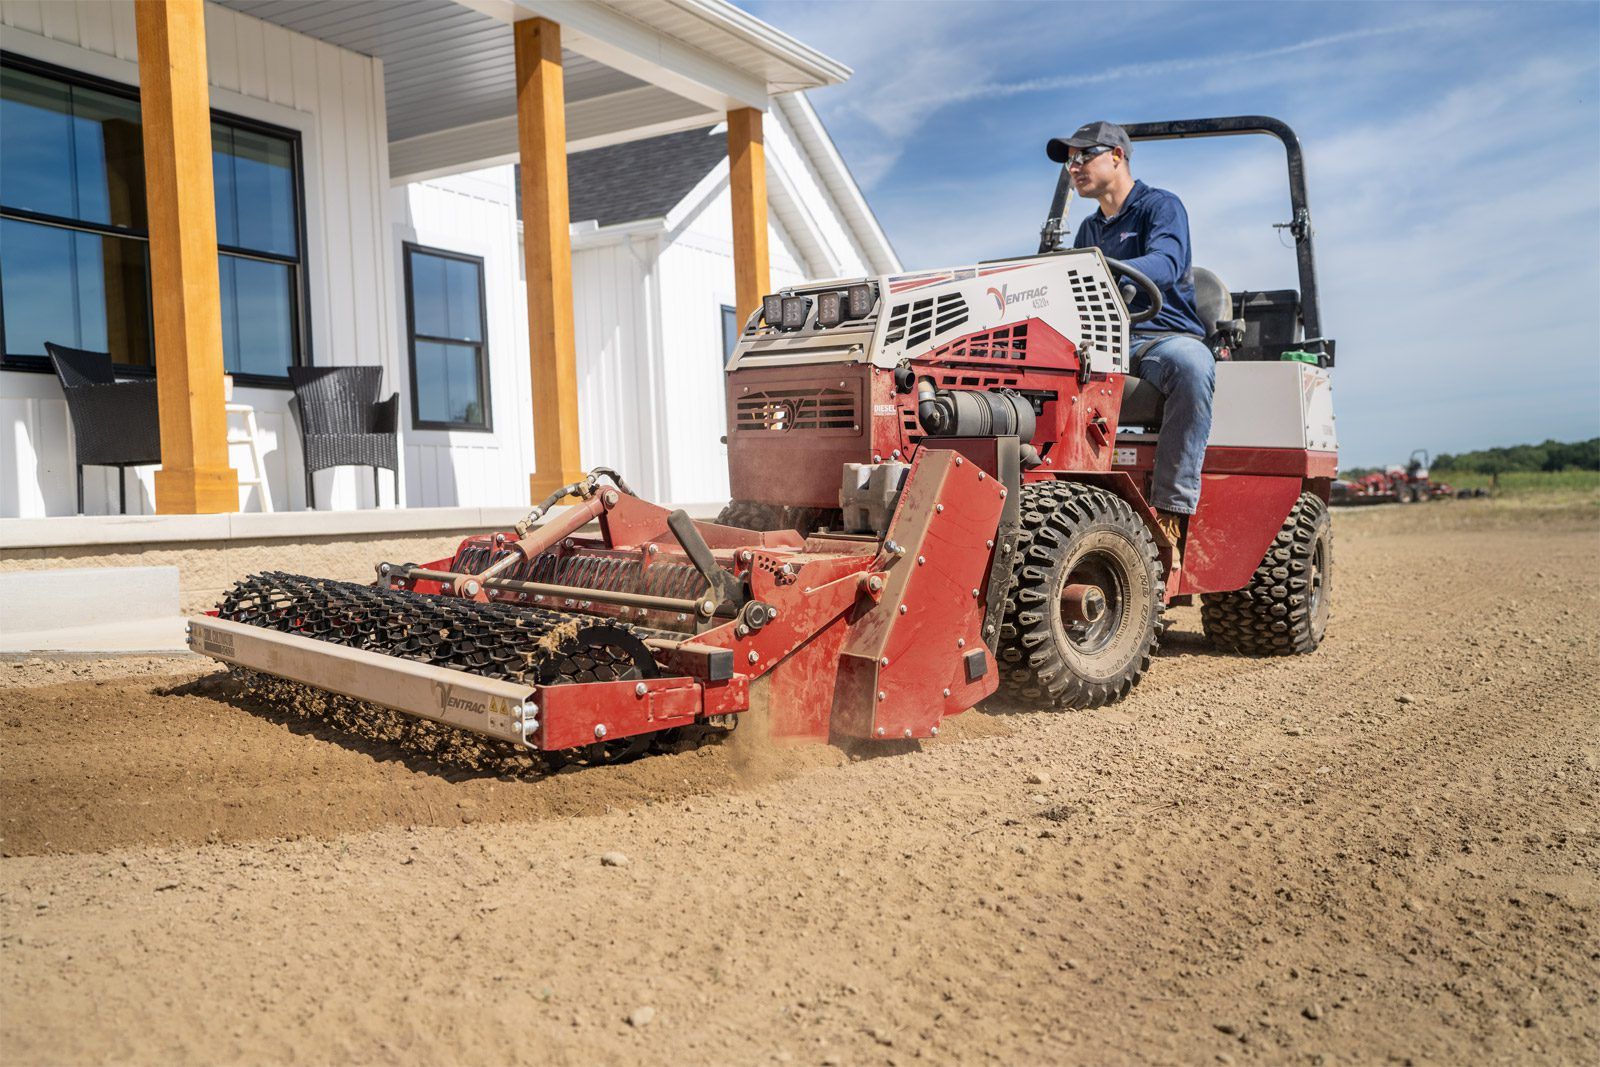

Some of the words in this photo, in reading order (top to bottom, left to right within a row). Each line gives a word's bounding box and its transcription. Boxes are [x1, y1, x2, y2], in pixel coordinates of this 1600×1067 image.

[986, 283, 1048, 320] VENTRAC
[874, 404, 897, 412] DIESEL
[435, 681, 486, 718] VENTRAC
